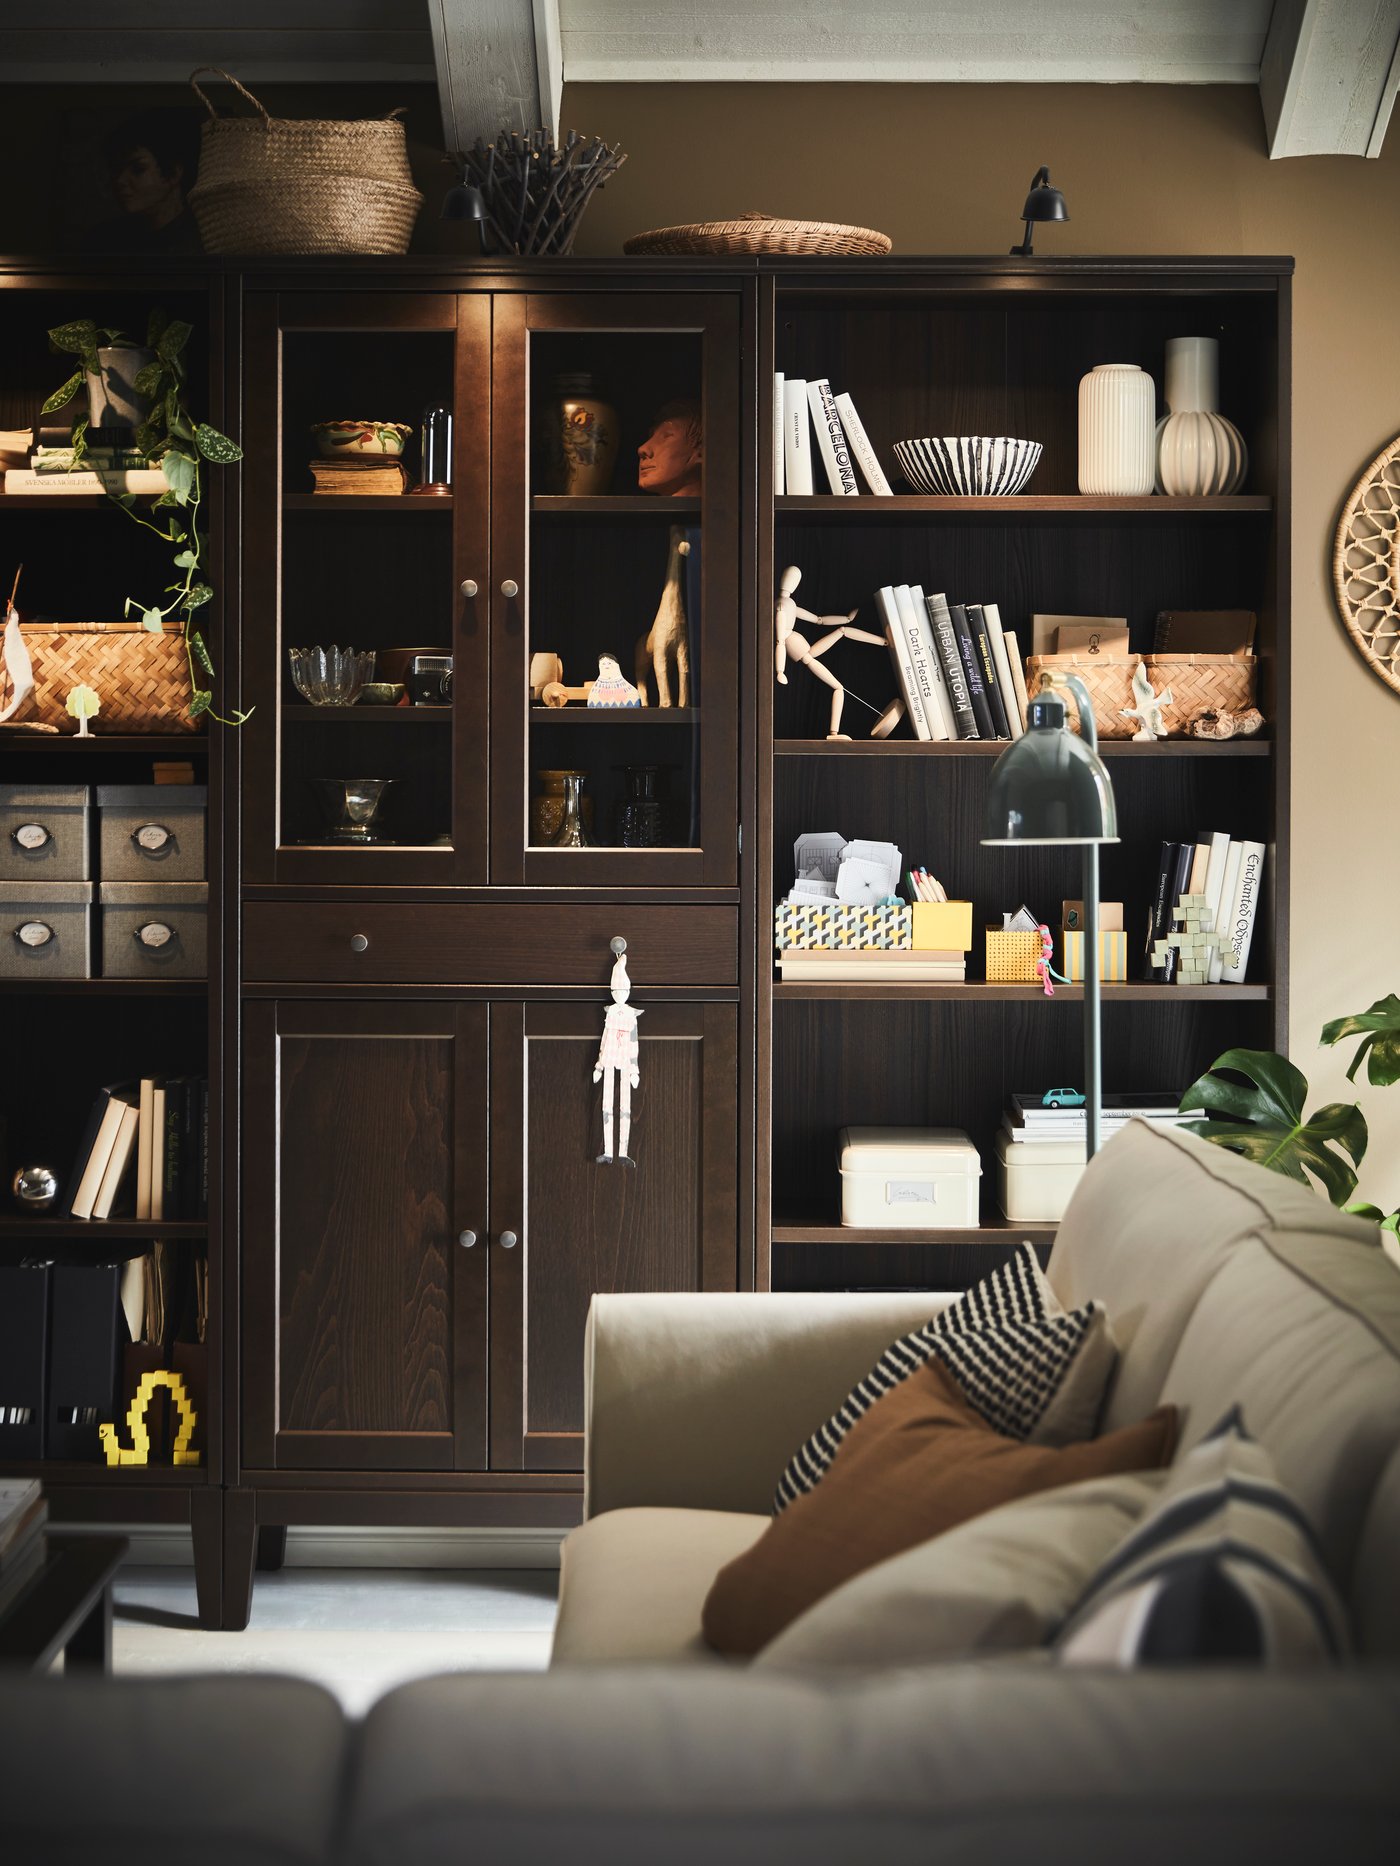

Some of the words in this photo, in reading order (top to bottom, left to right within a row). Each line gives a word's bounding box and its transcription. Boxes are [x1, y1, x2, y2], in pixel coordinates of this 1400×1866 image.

[818, 385, 856, 495] BARCELONA
[846, 410, 868, 454] SHERLOCK
[865, 456, 885, 492] HOLMES
[909, 628, 924, 656] Dark
[917, 659, 931, 698] Hearts
[937, 621, 956, 664] URBAN
[949, 668, 969, 712] UTOPIA
[961, 635, 972, 660] Living
[979, 634, 988, 659] European
[984, 658, 994, 684] Escapades
[905, 666, 915, 695] Beaming
[913, 697, 923, 722] Brightly
[969, 668, 981, 683] wild
[970, 684, 984, 695] life
[1156, 900, 1164, 927] Escapades
[1239, 854, 1260, 920] Enchanted
[1232, 919, 1248, 970] Odyss
